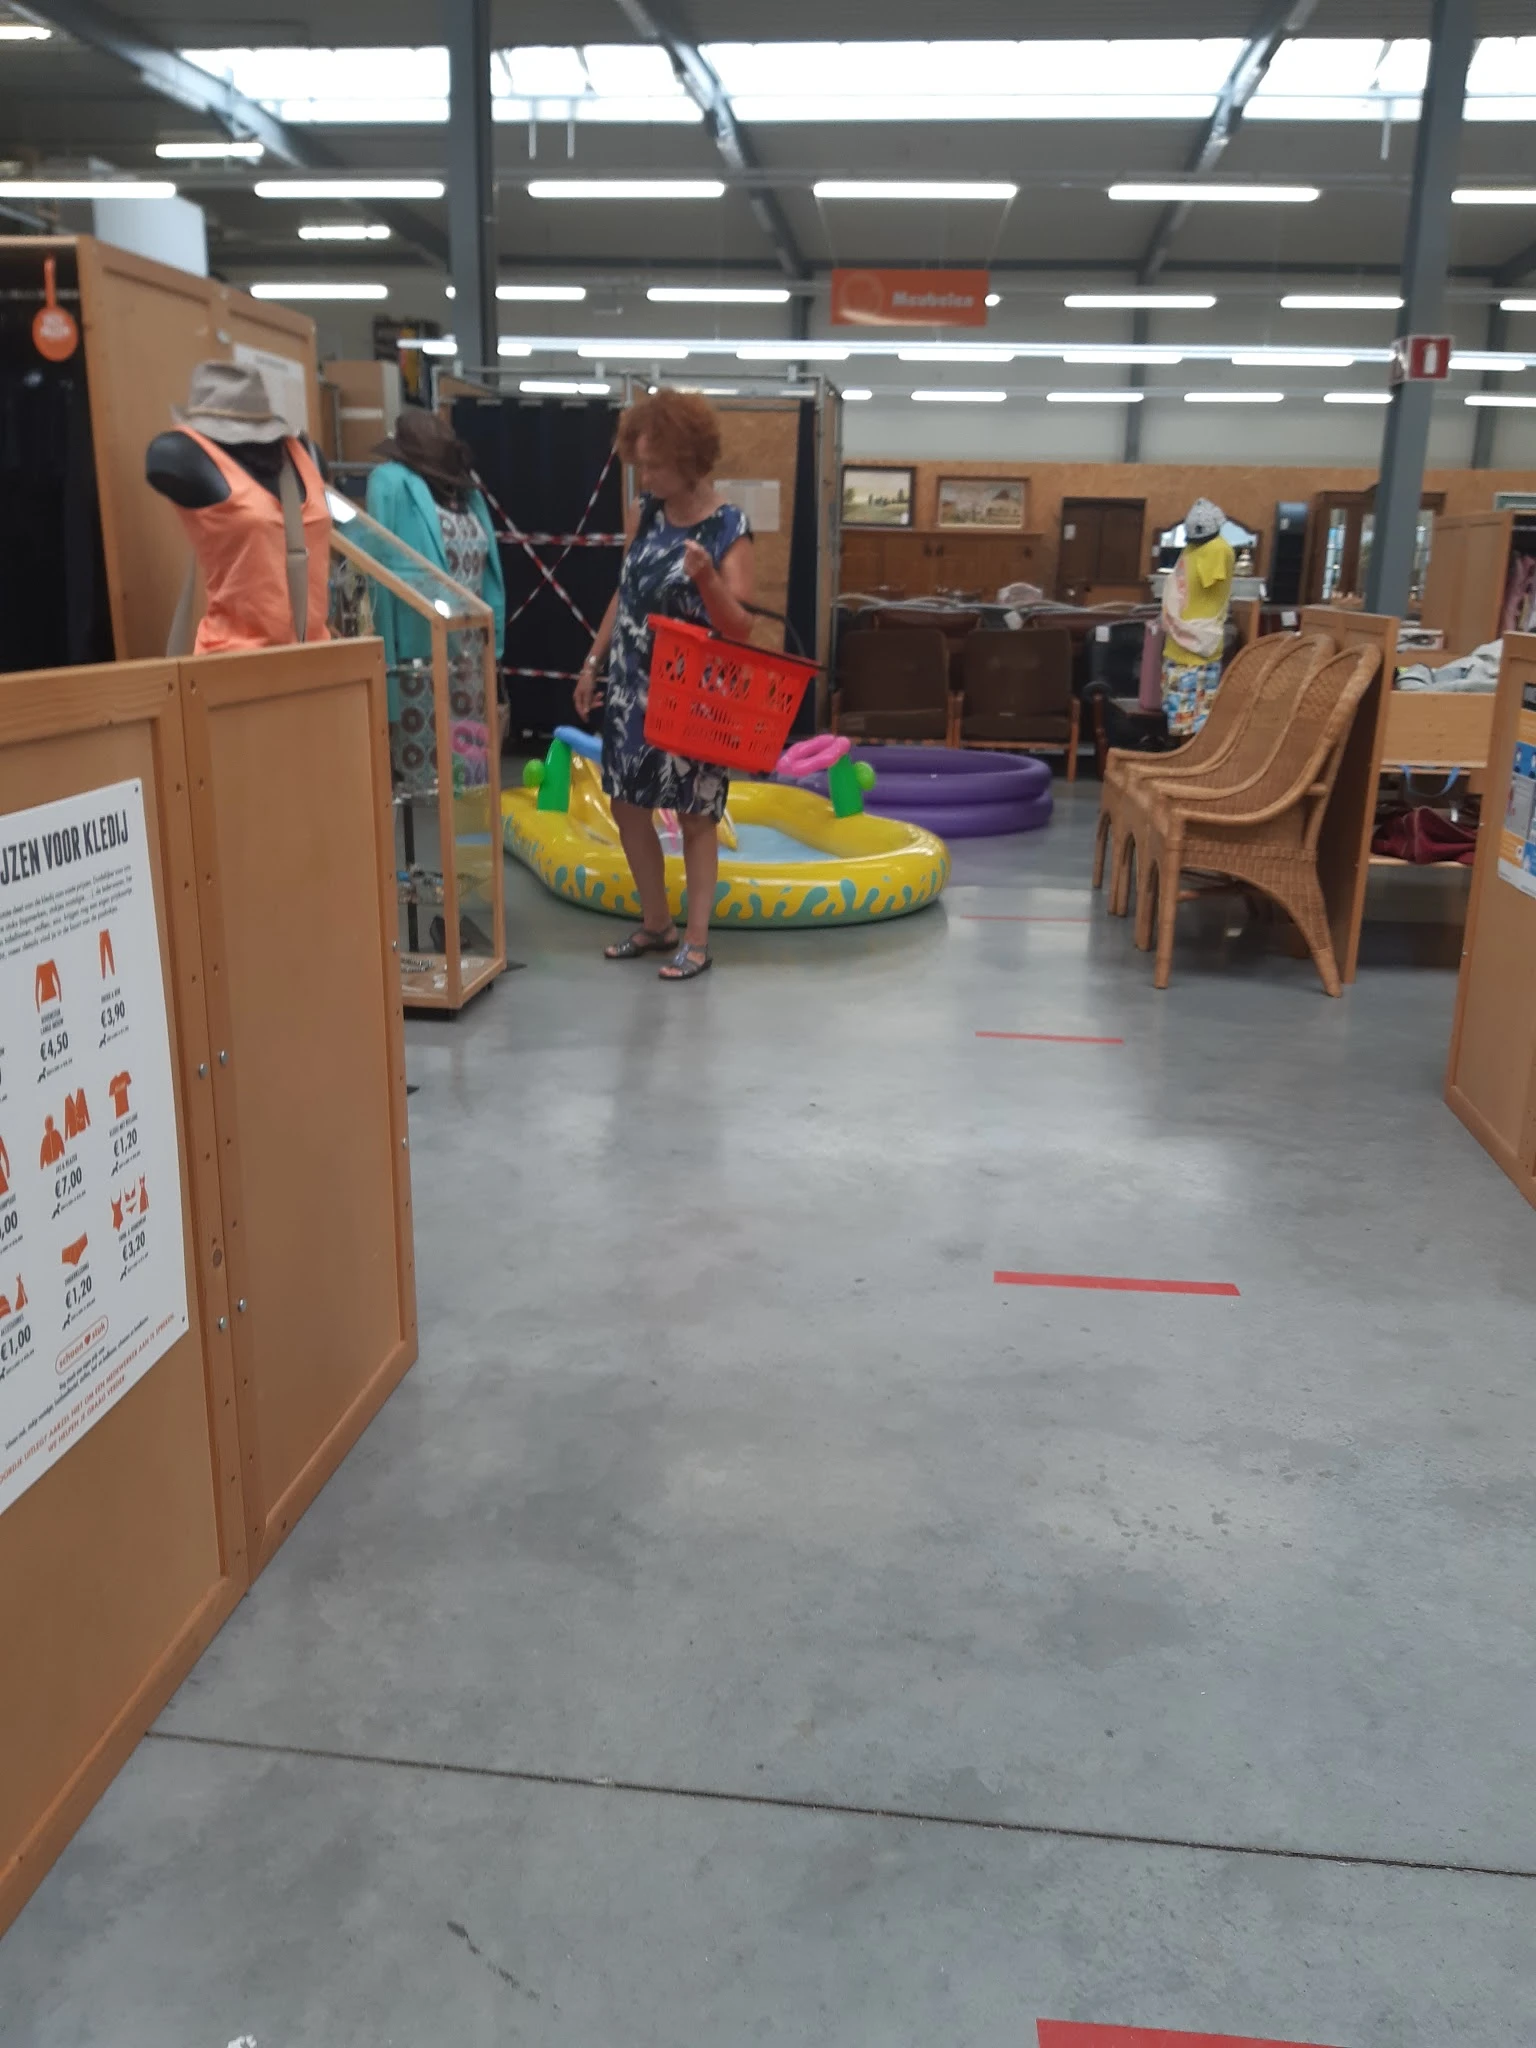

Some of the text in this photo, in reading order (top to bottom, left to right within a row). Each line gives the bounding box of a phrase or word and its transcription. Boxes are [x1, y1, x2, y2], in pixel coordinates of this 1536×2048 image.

[0, 837, 41, 886] JZEN
[42, 825, 82, 871] VOOR
[82, 808, 129, 858] KLEDIJ
[100, 1000, 126, 1029] €3,90
[39, 1030, 69, 1062] €4,50
[113, 1127, 138, 1158] €1,20
[54, 1166, 83, 1200] €7,00
[122, 1230, 146, 1262] €3,20
[65, 1274, 93, 1310] €1,20
[0, 1324, 31, 1362] €1,00
[59, 1342, 84, 1369] schoon
[91, 1321, 105, 1340] stuk
